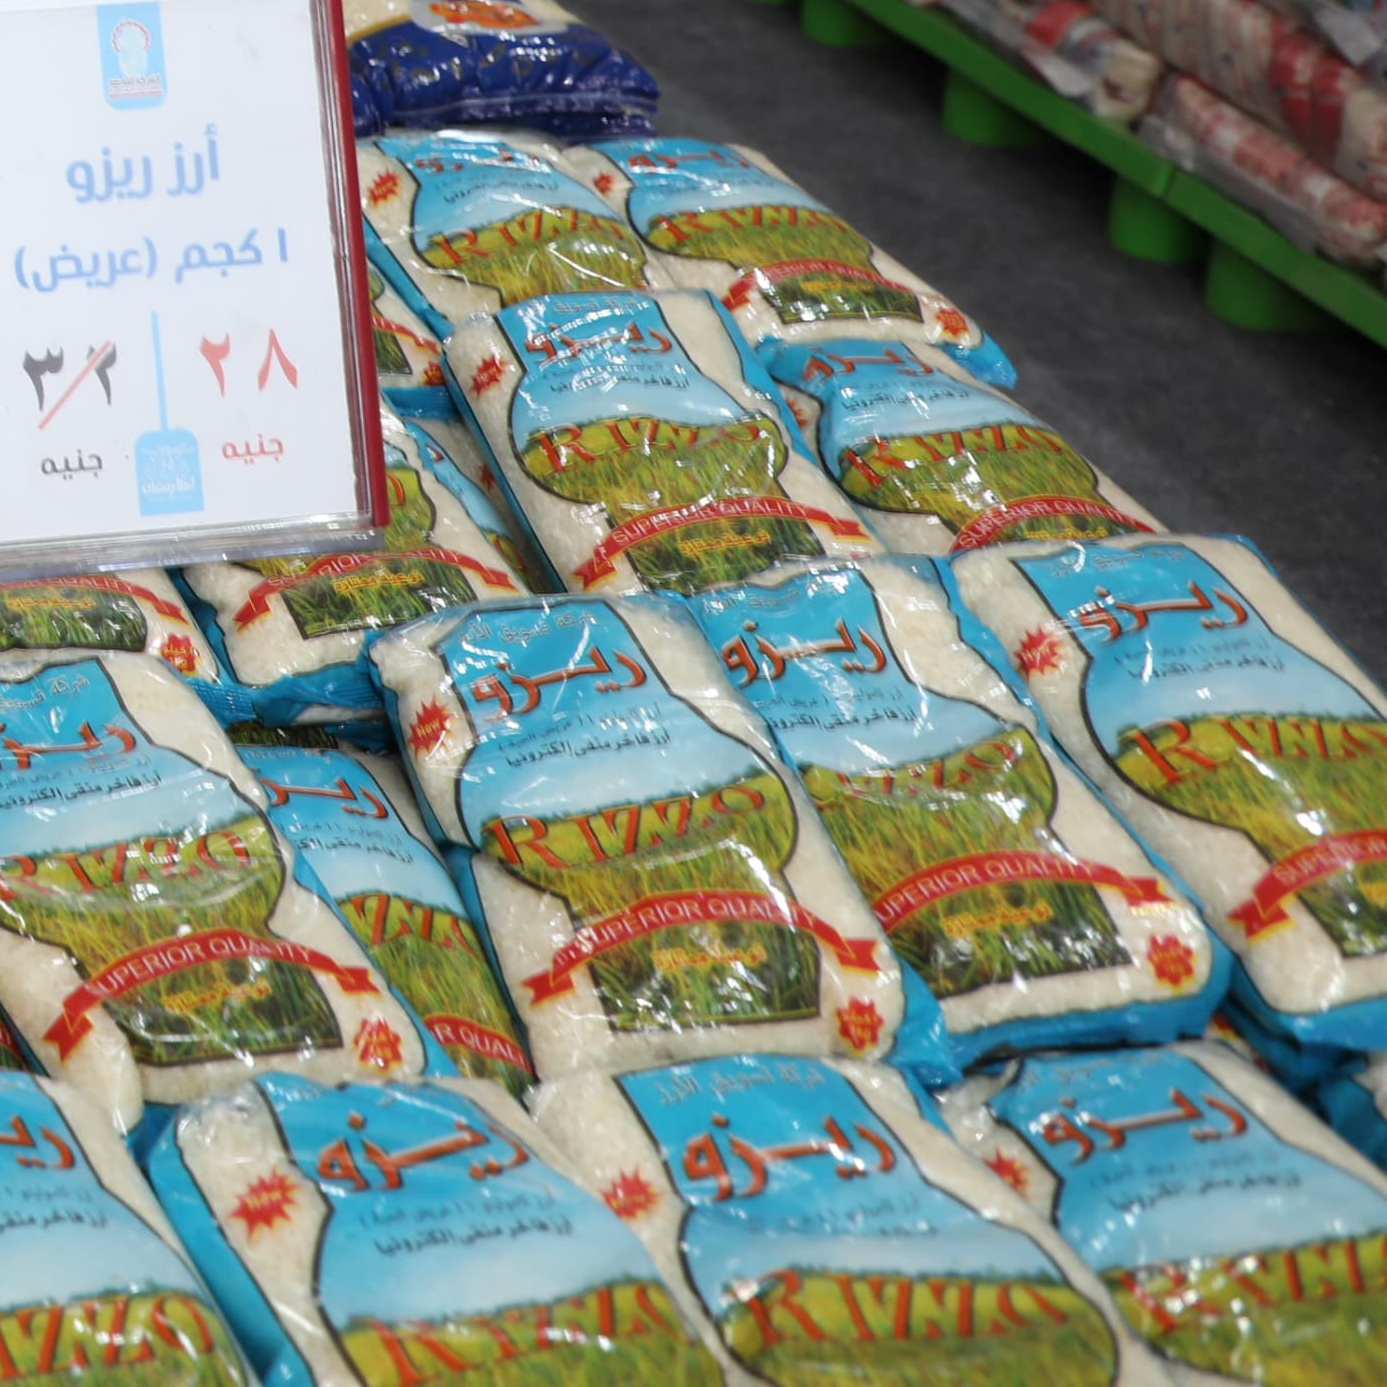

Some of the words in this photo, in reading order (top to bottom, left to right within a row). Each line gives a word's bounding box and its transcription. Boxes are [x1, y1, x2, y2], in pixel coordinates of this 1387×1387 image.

[66, 147, 153, 203] ريزو
[168, 124, 219, 195] أرز
[15, 237, 157, 291] (عريض)
[175, 229, 263, 284] كجم
[41, 451, 103, 476] جنيه
[222, 435, 283, 460] جنيه
[470, 646, 647, 724] ريزو
[721, 617, 887, 688] ريزو
[482, 782, 765, 871] RIZZO
[576, 897, 704, 955] SUPERIOR
[316, 1110, 529, 1191] ريزو
[683, 1110, 896, 1201] ريزو
